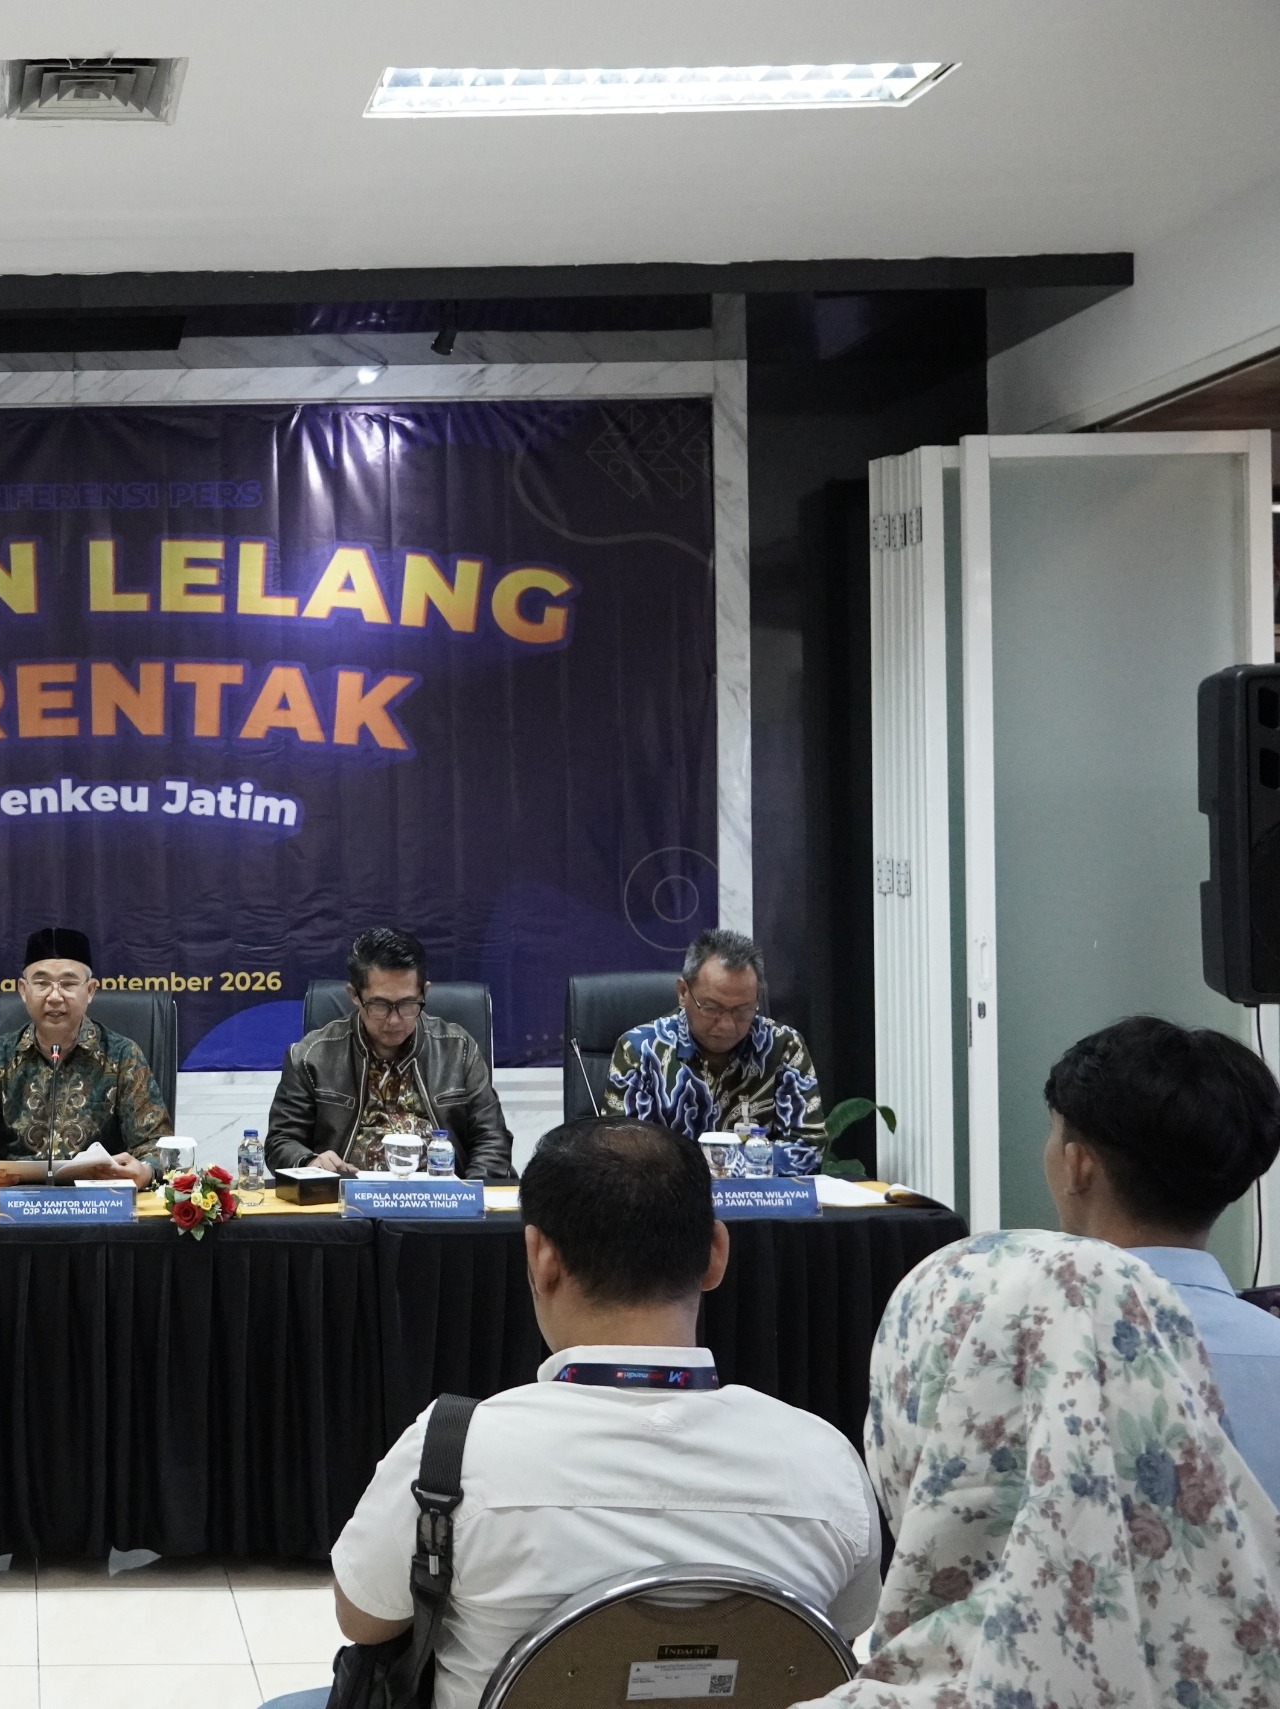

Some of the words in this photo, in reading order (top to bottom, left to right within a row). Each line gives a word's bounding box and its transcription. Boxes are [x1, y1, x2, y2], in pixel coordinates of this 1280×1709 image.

[171, 480, 262, 508] PERS
[88, 538, 575, 645] LELANG
[162, 779, 297, 825] Jatim
[95, 971, 213, 992] ptember
[220, 971, 282, 992] 2026
[433, 1193, 476, 1201] WILAYAH
[712, 1191, 723, 1199] LA
[725, 1191, 763, 1199] KANTOR
[765, 1191, 809, 1199] WILAYAH
[8, 1200, 41, 1208] KEPALA
[44, 1200, 80, 1208] KANTOR
[373, 1200, 397, 1208] DJKN
